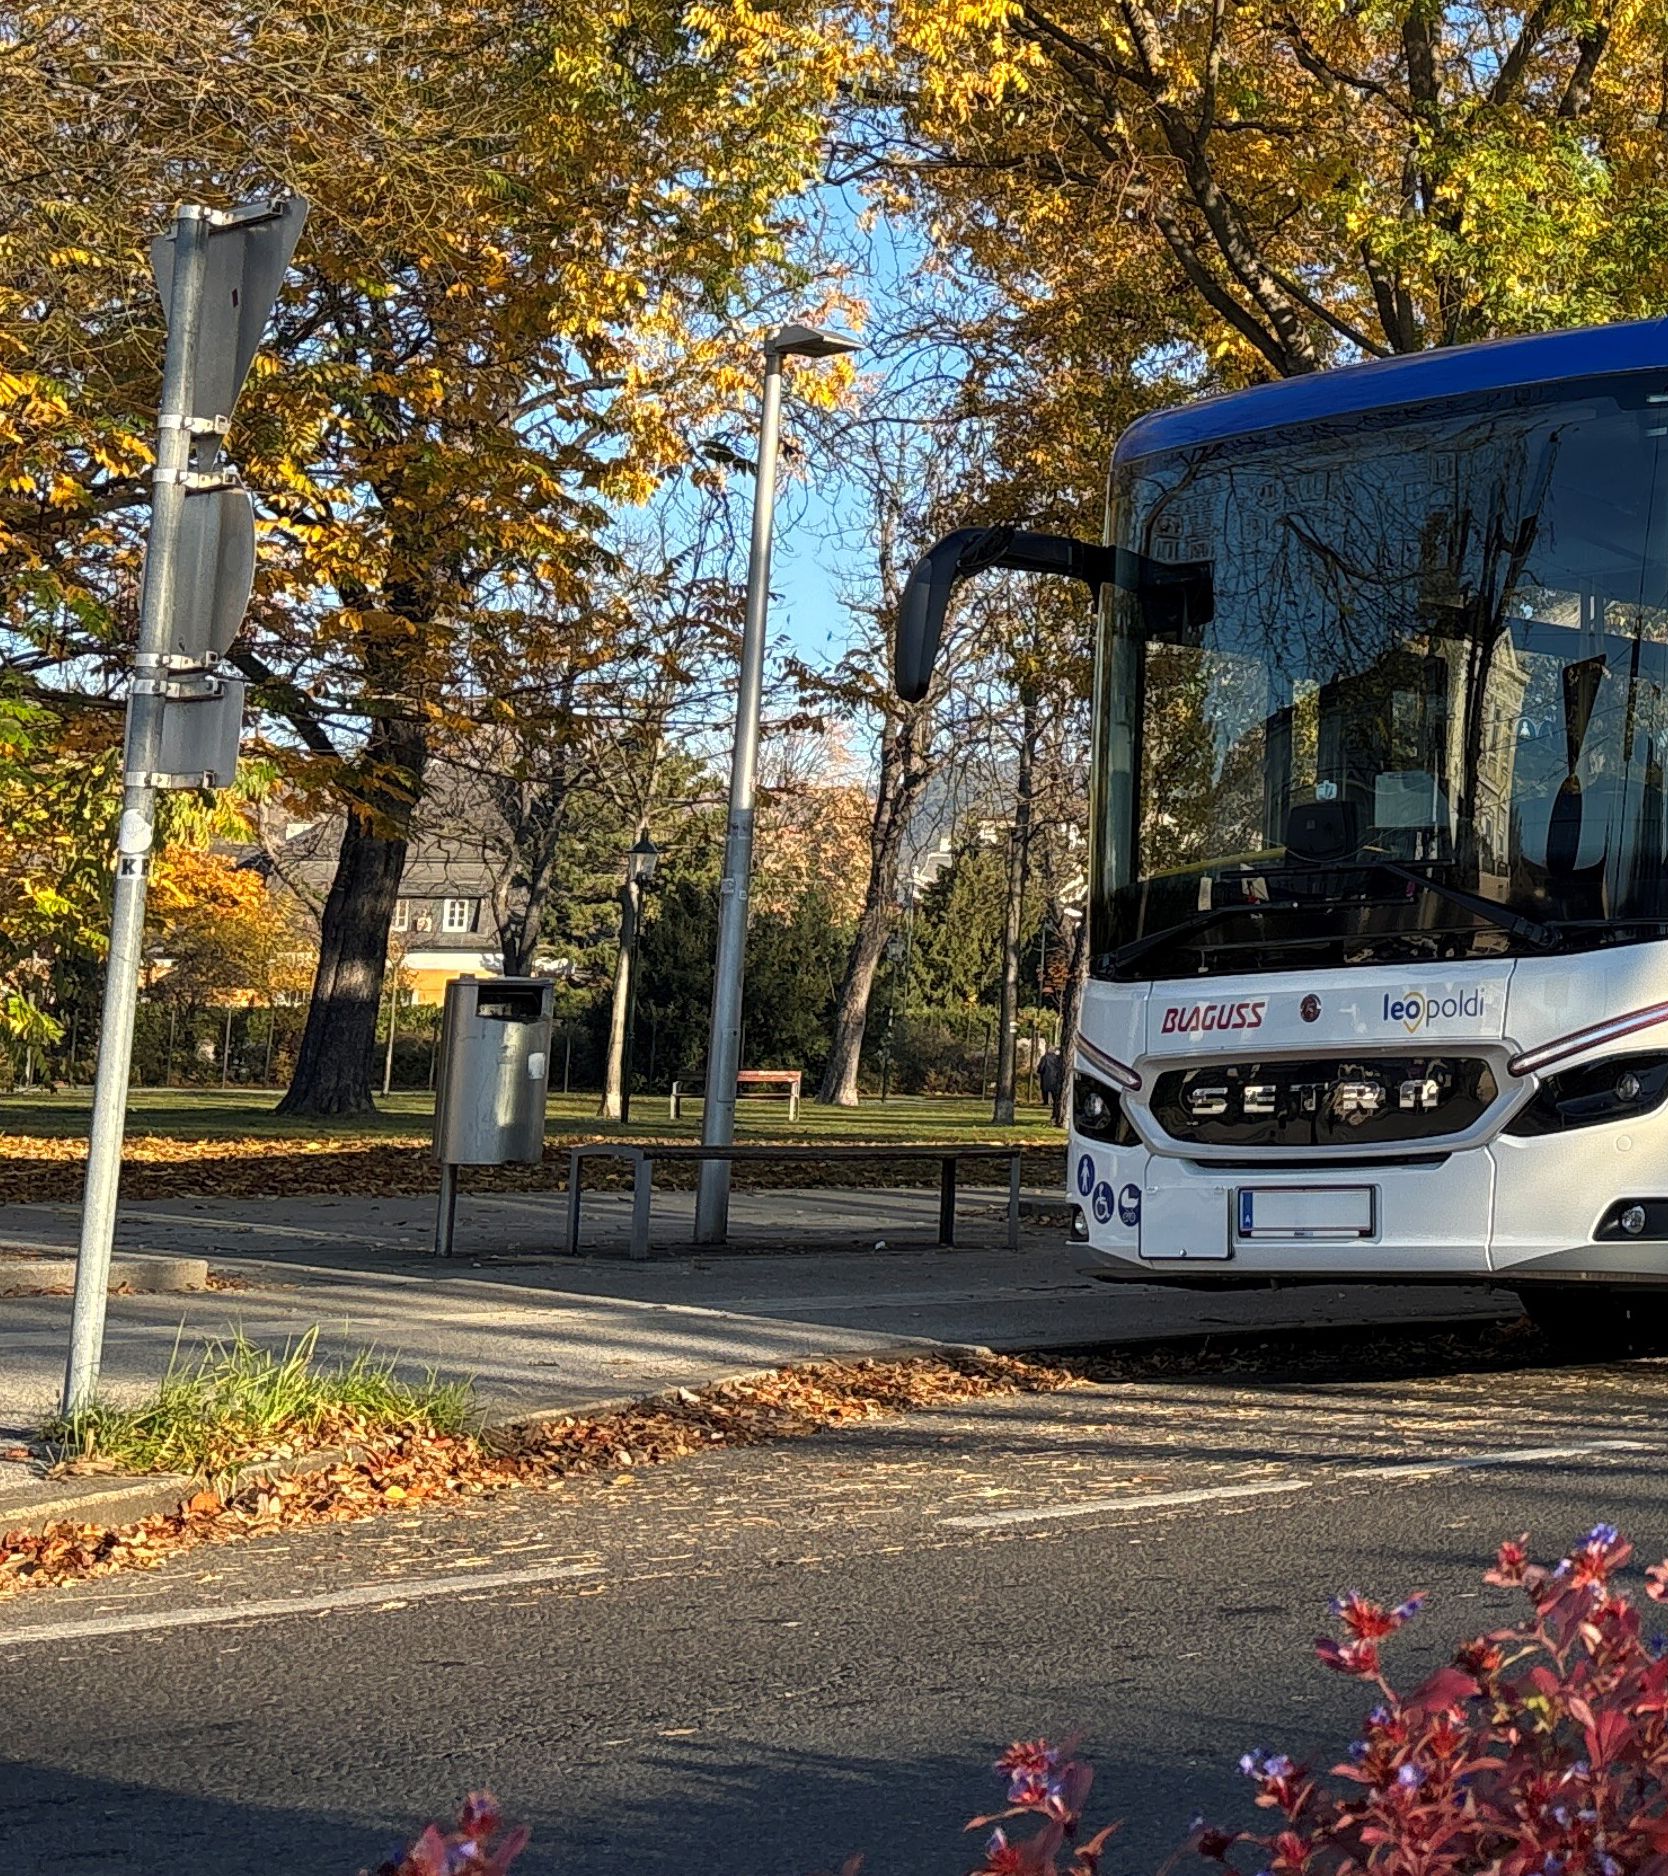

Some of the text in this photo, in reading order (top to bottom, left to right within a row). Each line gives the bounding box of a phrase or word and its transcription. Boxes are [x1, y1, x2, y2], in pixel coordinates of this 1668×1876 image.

[1161, 1001, 1267, 1034] BLAGUSS
[1383, 988, 1485, 1027] leopoldi
[1191, 1079, 1439, 1115] SETRA
